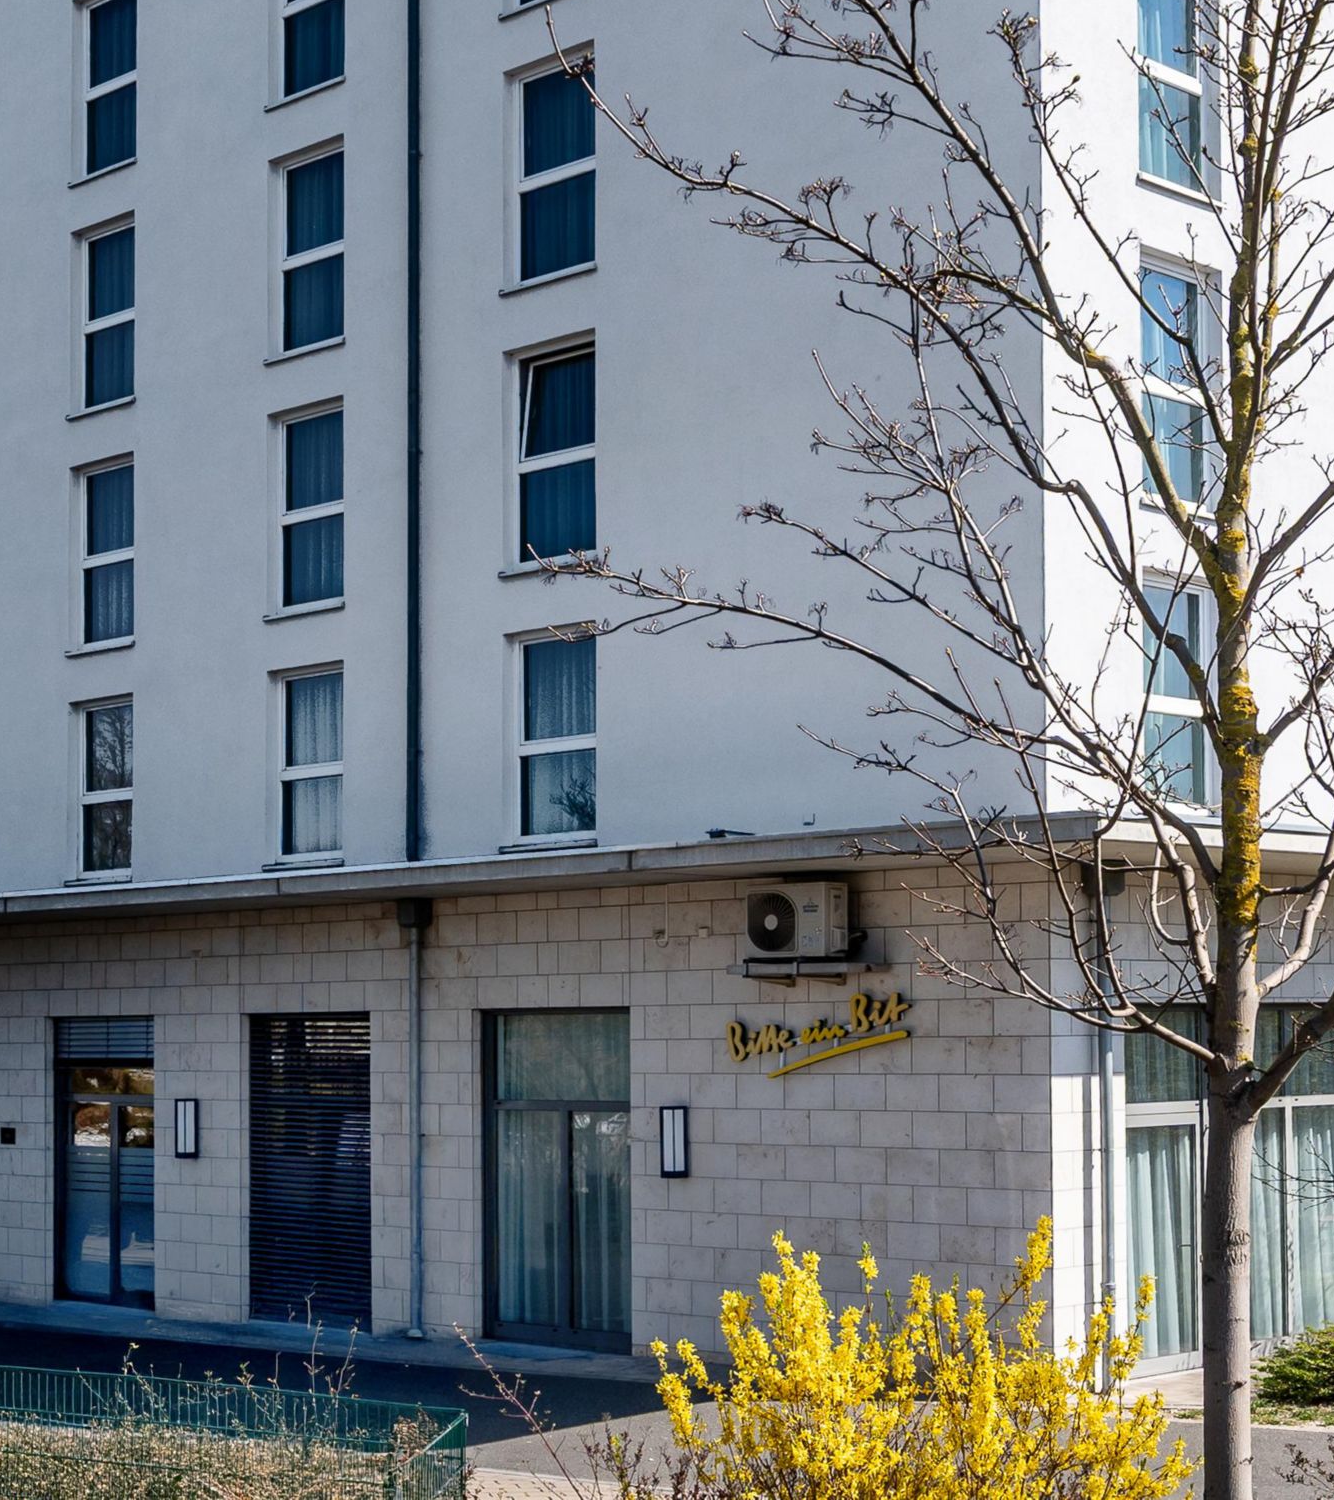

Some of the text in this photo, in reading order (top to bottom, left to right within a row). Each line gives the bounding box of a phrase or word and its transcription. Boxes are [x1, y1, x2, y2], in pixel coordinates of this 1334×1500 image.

[726, 992, 910, 1062] Bitte ein Bit
